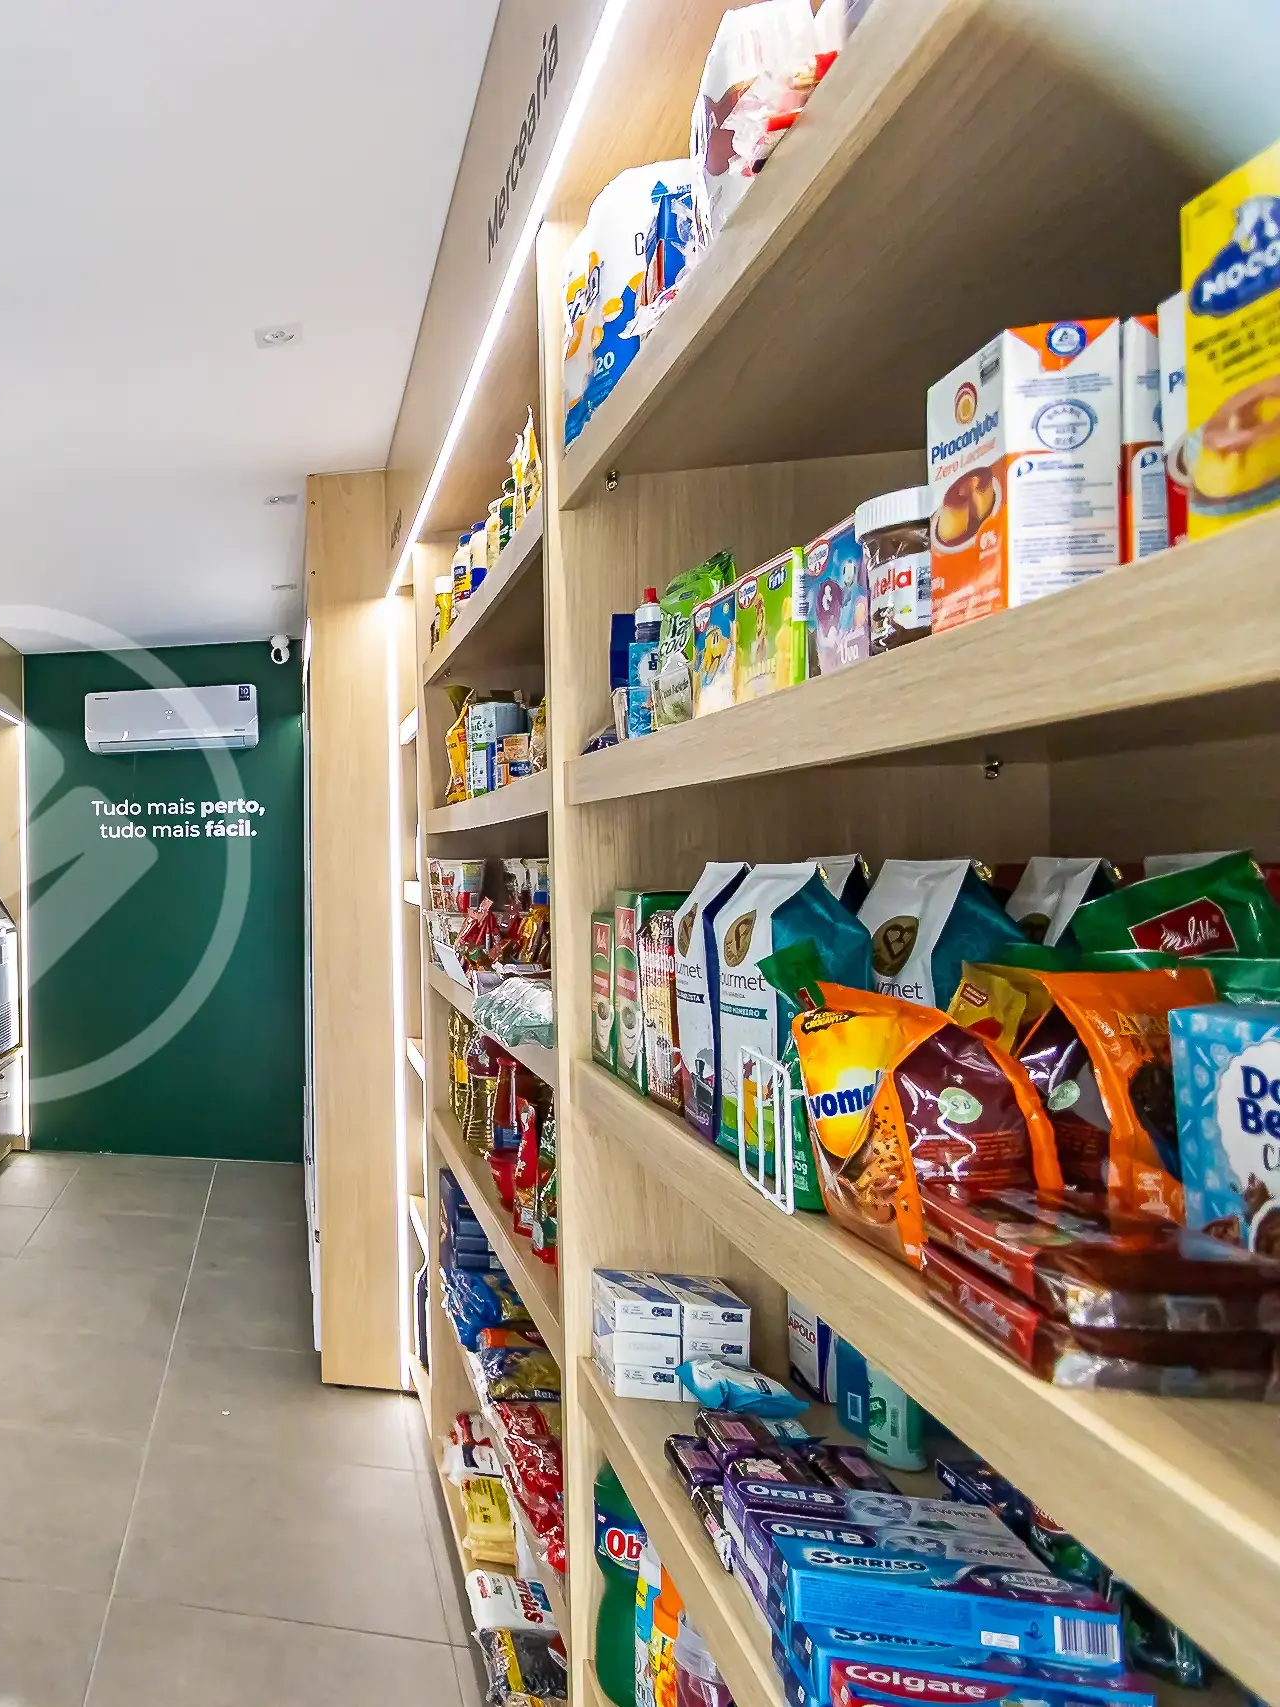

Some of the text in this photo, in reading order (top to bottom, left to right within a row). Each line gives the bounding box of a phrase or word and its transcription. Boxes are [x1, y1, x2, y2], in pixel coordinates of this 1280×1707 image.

[486, 23, 559, 264] Mercearia
[930, 410, 1000, 465] Piracanjuba
[935, 456, 960, 481] Zero
[837, 637, 860, 665] Uva
[91, 797, 266, 818] Tudo mais perto,
[100, 820, 258, 838] tudo mais fácil.
[1159, 914, 1220, 951] Melitta
[745, 1483, 836, 1505] Oral-B
[771, 1522, 866, 1546] Oral-B
[810, 1550, 928, 1572] SORRISO
[844, 1664, 988, 1698] Colgate
